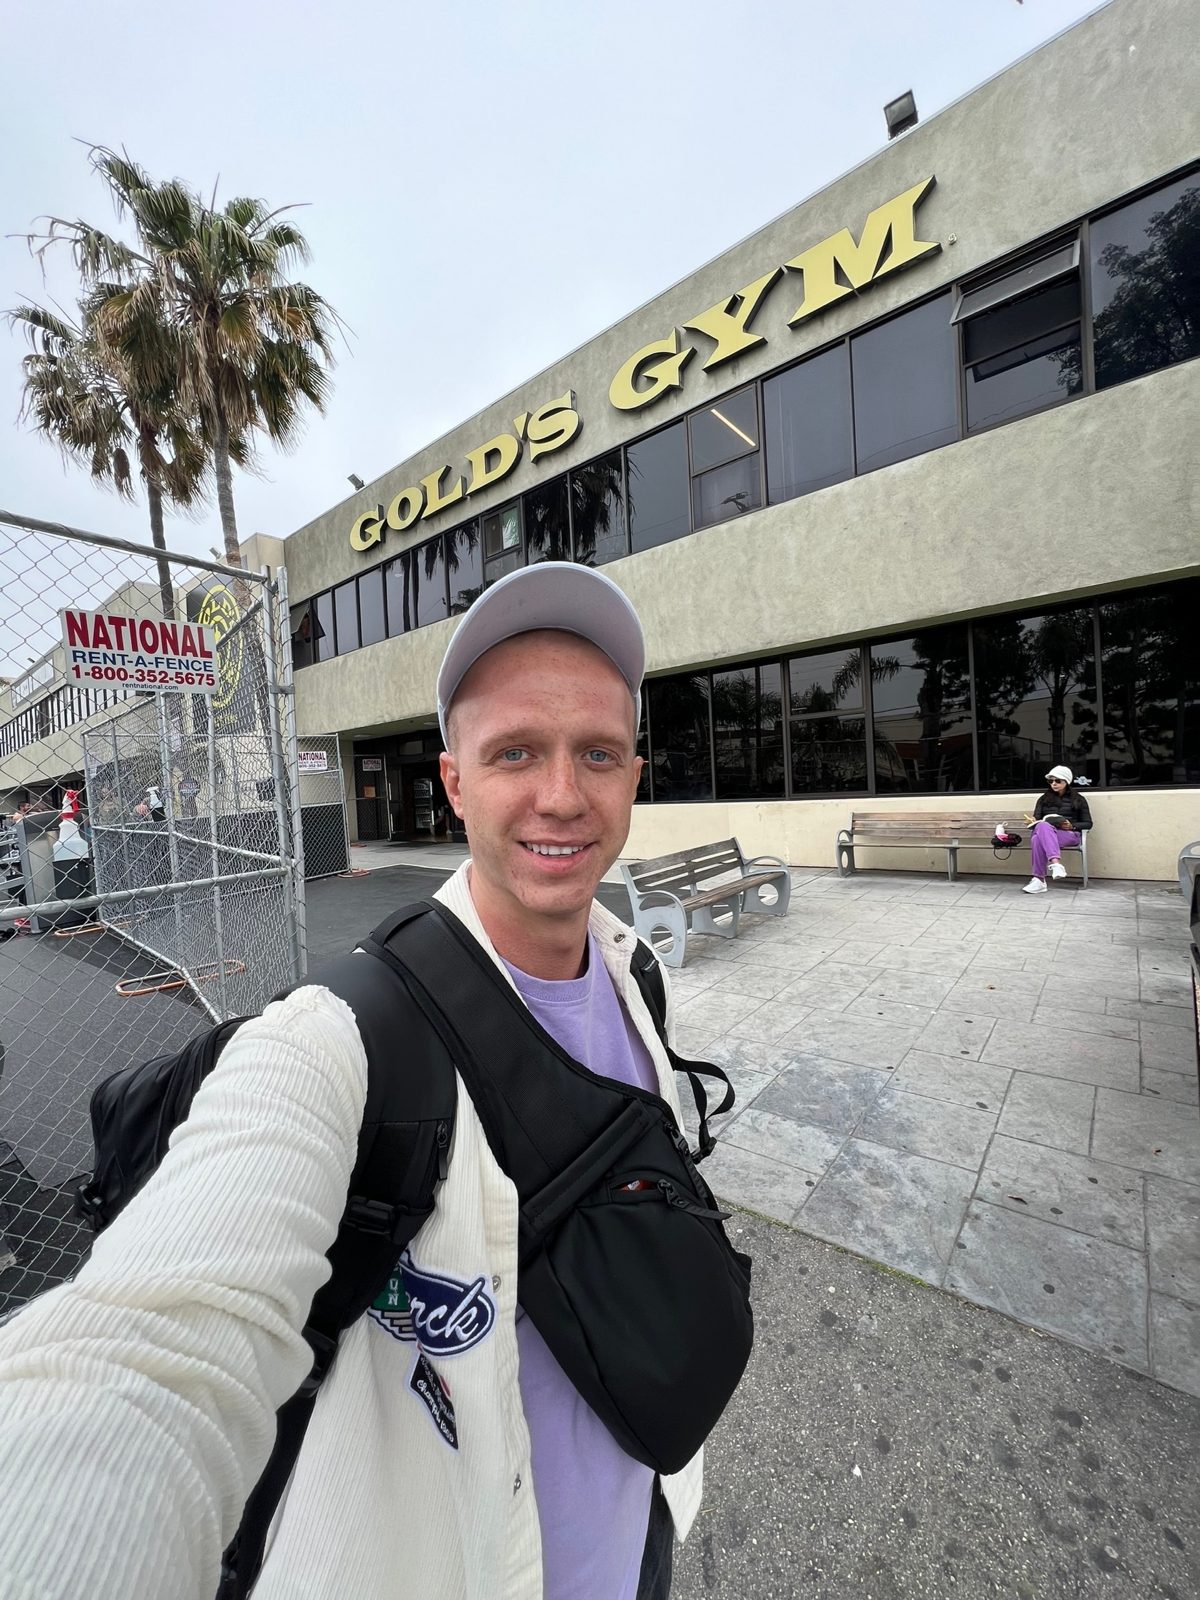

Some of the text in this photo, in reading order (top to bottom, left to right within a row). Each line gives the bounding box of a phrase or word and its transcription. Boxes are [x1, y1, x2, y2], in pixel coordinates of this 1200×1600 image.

[349, 175, 942, 552] GOLD'S GYM
[65, 610, 213, 659] NATIONAL
[72, 650, 214, 673] RENT-A-FENCE
[72, 664, 216, 687] 1-800-352-5675
[122, 682, 179, 691] rentnational.com
[298, 752, 326, 761] NATIONAL
[405, 1280, 482, 1341] rck
